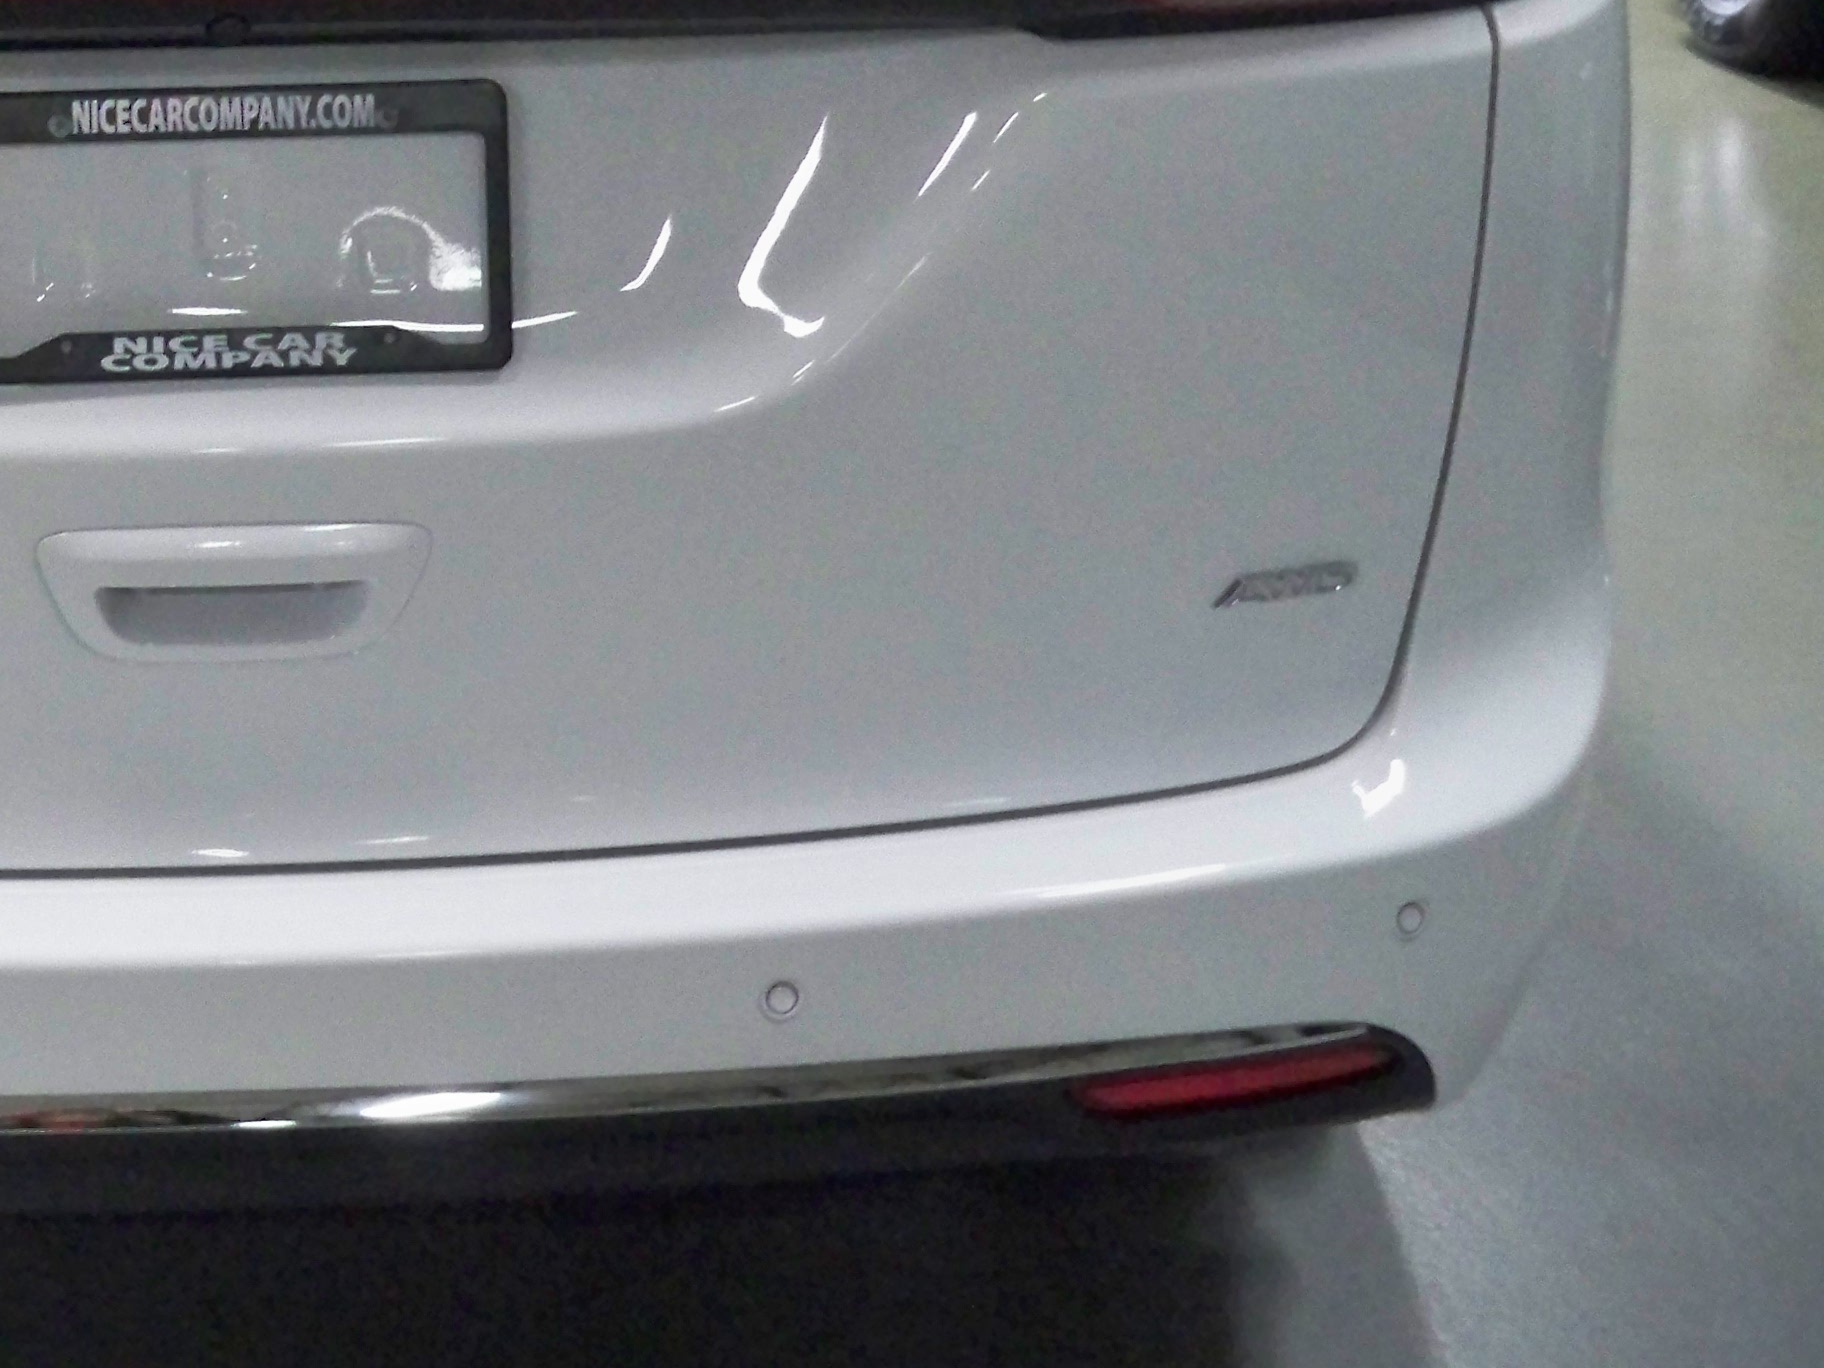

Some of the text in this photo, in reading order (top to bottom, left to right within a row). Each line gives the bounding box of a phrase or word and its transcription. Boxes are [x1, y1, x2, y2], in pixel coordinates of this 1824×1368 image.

[71, 93, 375, 135] NICECARCOMPANY.COM
[112, 332, 347, 354] NICE CAR
[100, 347, 358, 372] COMPANY
